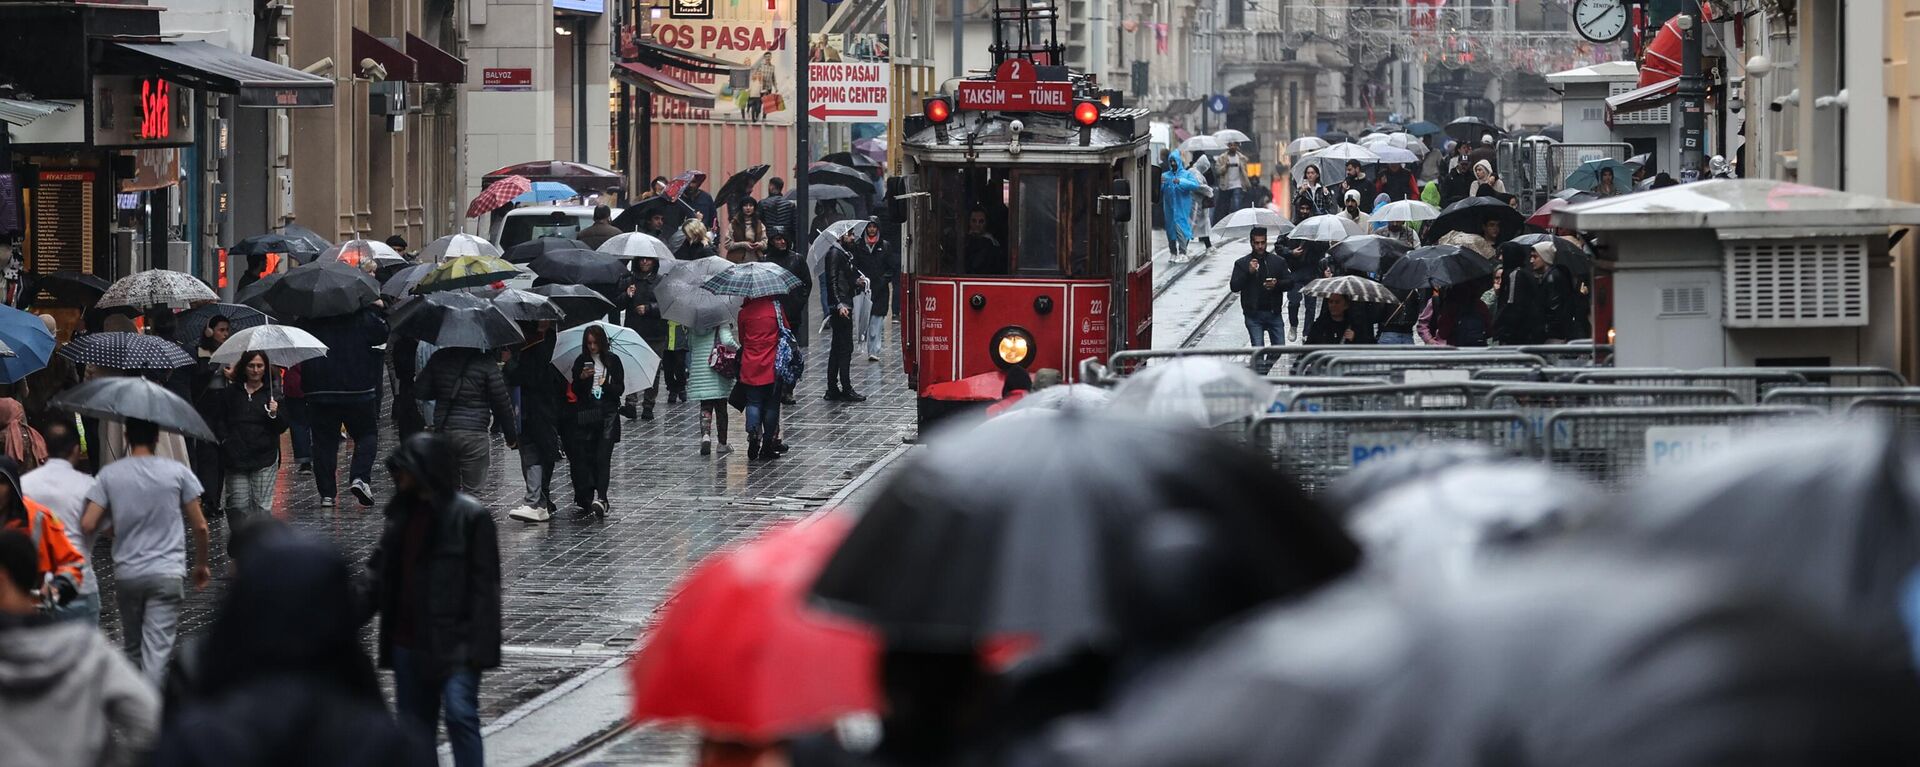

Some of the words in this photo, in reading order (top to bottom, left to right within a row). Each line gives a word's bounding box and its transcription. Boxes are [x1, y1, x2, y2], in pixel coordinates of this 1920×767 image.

[701, 26, 786, 51] PASAJI
[486, 71, 512, 79] BALYOZ
[808, 65, 843, 82] ERKOS
[846, 65, 880, 82] PASAJI
[1011, 61, 1020, 80] 2
[808, 87, 846, 103] OPPING
[848, 87, 887, 103] CENTER
[963, 86, 1006, 105] TAKSİM
[1029, 86, 1067, 105] TÜNEL
[925, 296, 936, 312] 223
[1090, 300, 1102, 315] 223
